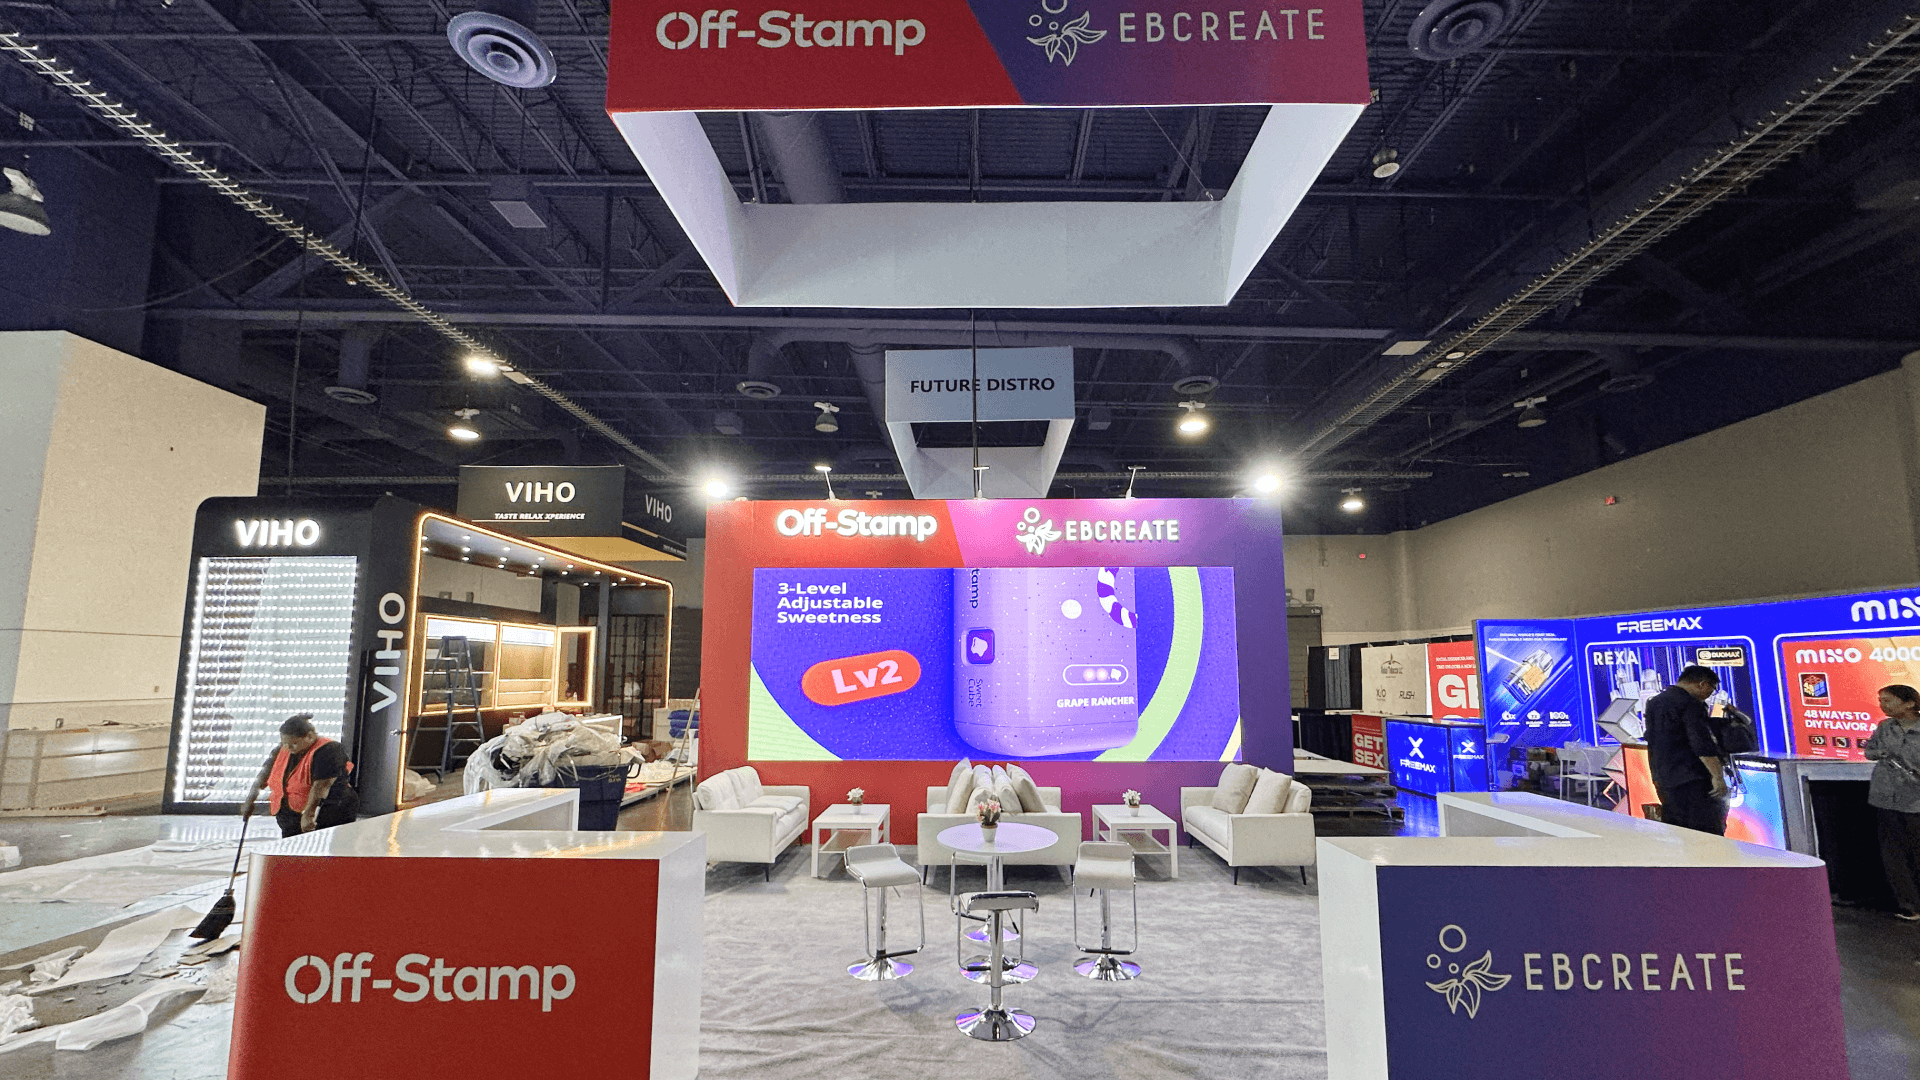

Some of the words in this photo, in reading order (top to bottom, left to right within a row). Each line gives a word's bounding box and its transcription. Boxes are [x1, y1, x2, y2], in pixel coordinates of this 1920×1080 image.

[655, 9, 927, 56] Off-Stamp
[1119, 7, 1327, 43] EBCREATE
[910, 379, 981, 394] FUTURE
[987, 377, 1056, 392] DISTRO
[505, 481, 577, 503] VIHO
[494, 512, 518, 521] TASTE
[519, 512, 543, 521] RELAX
[545, 512, 586, 521] XPERIENCE
[645, 493, 673, 524] VIHO
[234, 517, 321, 547] VIHO
[776, 507, 938, 542] Off-Stamp
[1065, 518, 1181, 543] EBCREATE
[777, 581, 848, 596] 3-Level
[776, 596, 884, 613] Adjustable
[776, 611, 883, 625] Sweetness
[1616, 616, 1703, 634] FREEMAX
[370, 591, 407, 714] VIHO
[1593, 650, 1639, 666] REXA
[1868, 646, 1920, 663] 4000
[830, 659, 903, 695] Lv2
[968, 678, 976, 707] Cube
[976, 678, 984, 708] Sweet
[1056, 697, 1090, 709] GRAPE
[1090, 696, 1136, 707] RANCHER
[1804, 710, 1818, 719] 48
[1818, 710, 1852, 721] WAYS
[1854, 711, 1871, 721] TO
[1804, 719, 1822, 729] DIY
[1824, 720, 1868, 732] FLAVOR
[1354, 733, 1384, 751] GET
[1354, 748, 1385, 769] SEX
[1400, 758, 1436, 773] FREEMAX
[284, 951, 577, 1013] Off-Stamp
[1523, 952, 1747, 992] EBCREATE
